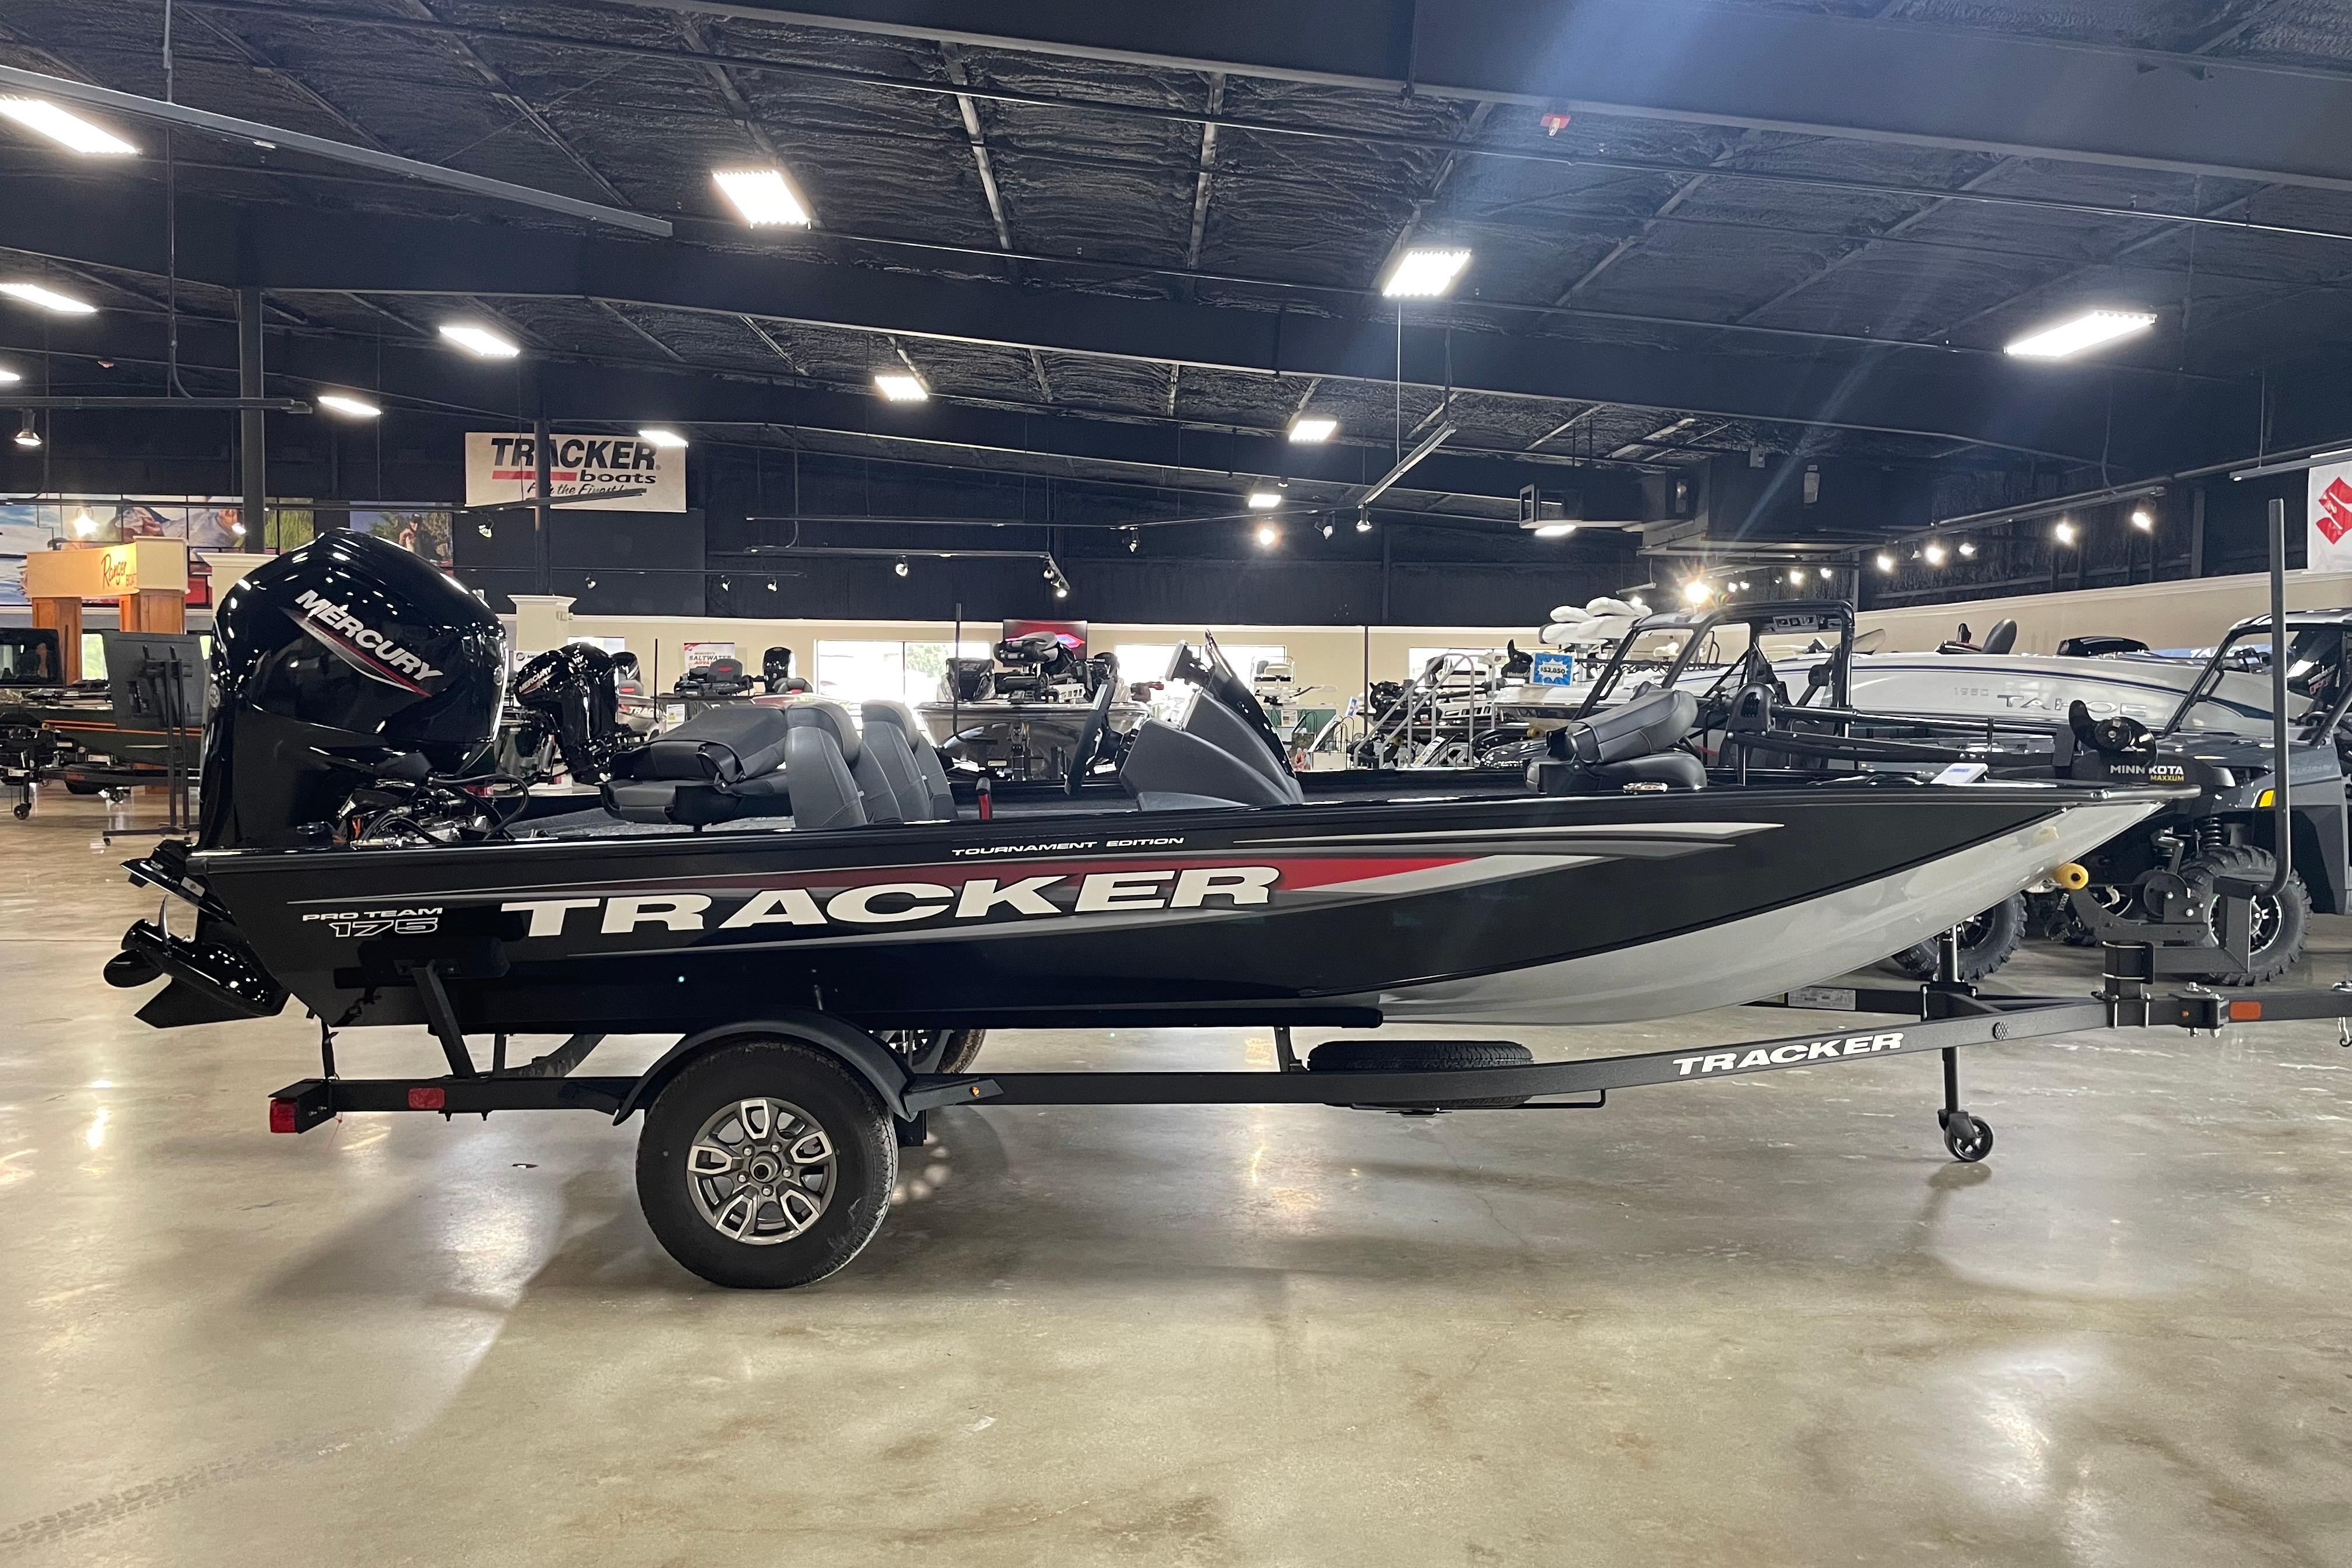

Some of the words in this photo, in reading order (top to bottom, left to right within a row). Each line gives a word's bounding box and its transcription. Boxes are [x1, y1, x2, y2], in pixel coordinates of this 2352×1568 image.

[579, 470, 656, 484] boats
[558, 484, 576, 495] the
[101, 554, 127, 589] Ranger
[295, 589, 443, 681] MERCURY
[2110, 765, 2146, 774] MINN
[2148, 765, 2184, 775] KOTA
[952, 841, 1098, 856] TOURNAMENT
[1106, 837, 1184, 848] EDITION
[501, 866, 1282, 937] TRACKER
[302, 912, 359, 922] PRO
[363, 907, 443, 918] TEAM
[328, 917, 438, 937] 175
[1672, 1032, 1904, 1076] TRACKER
